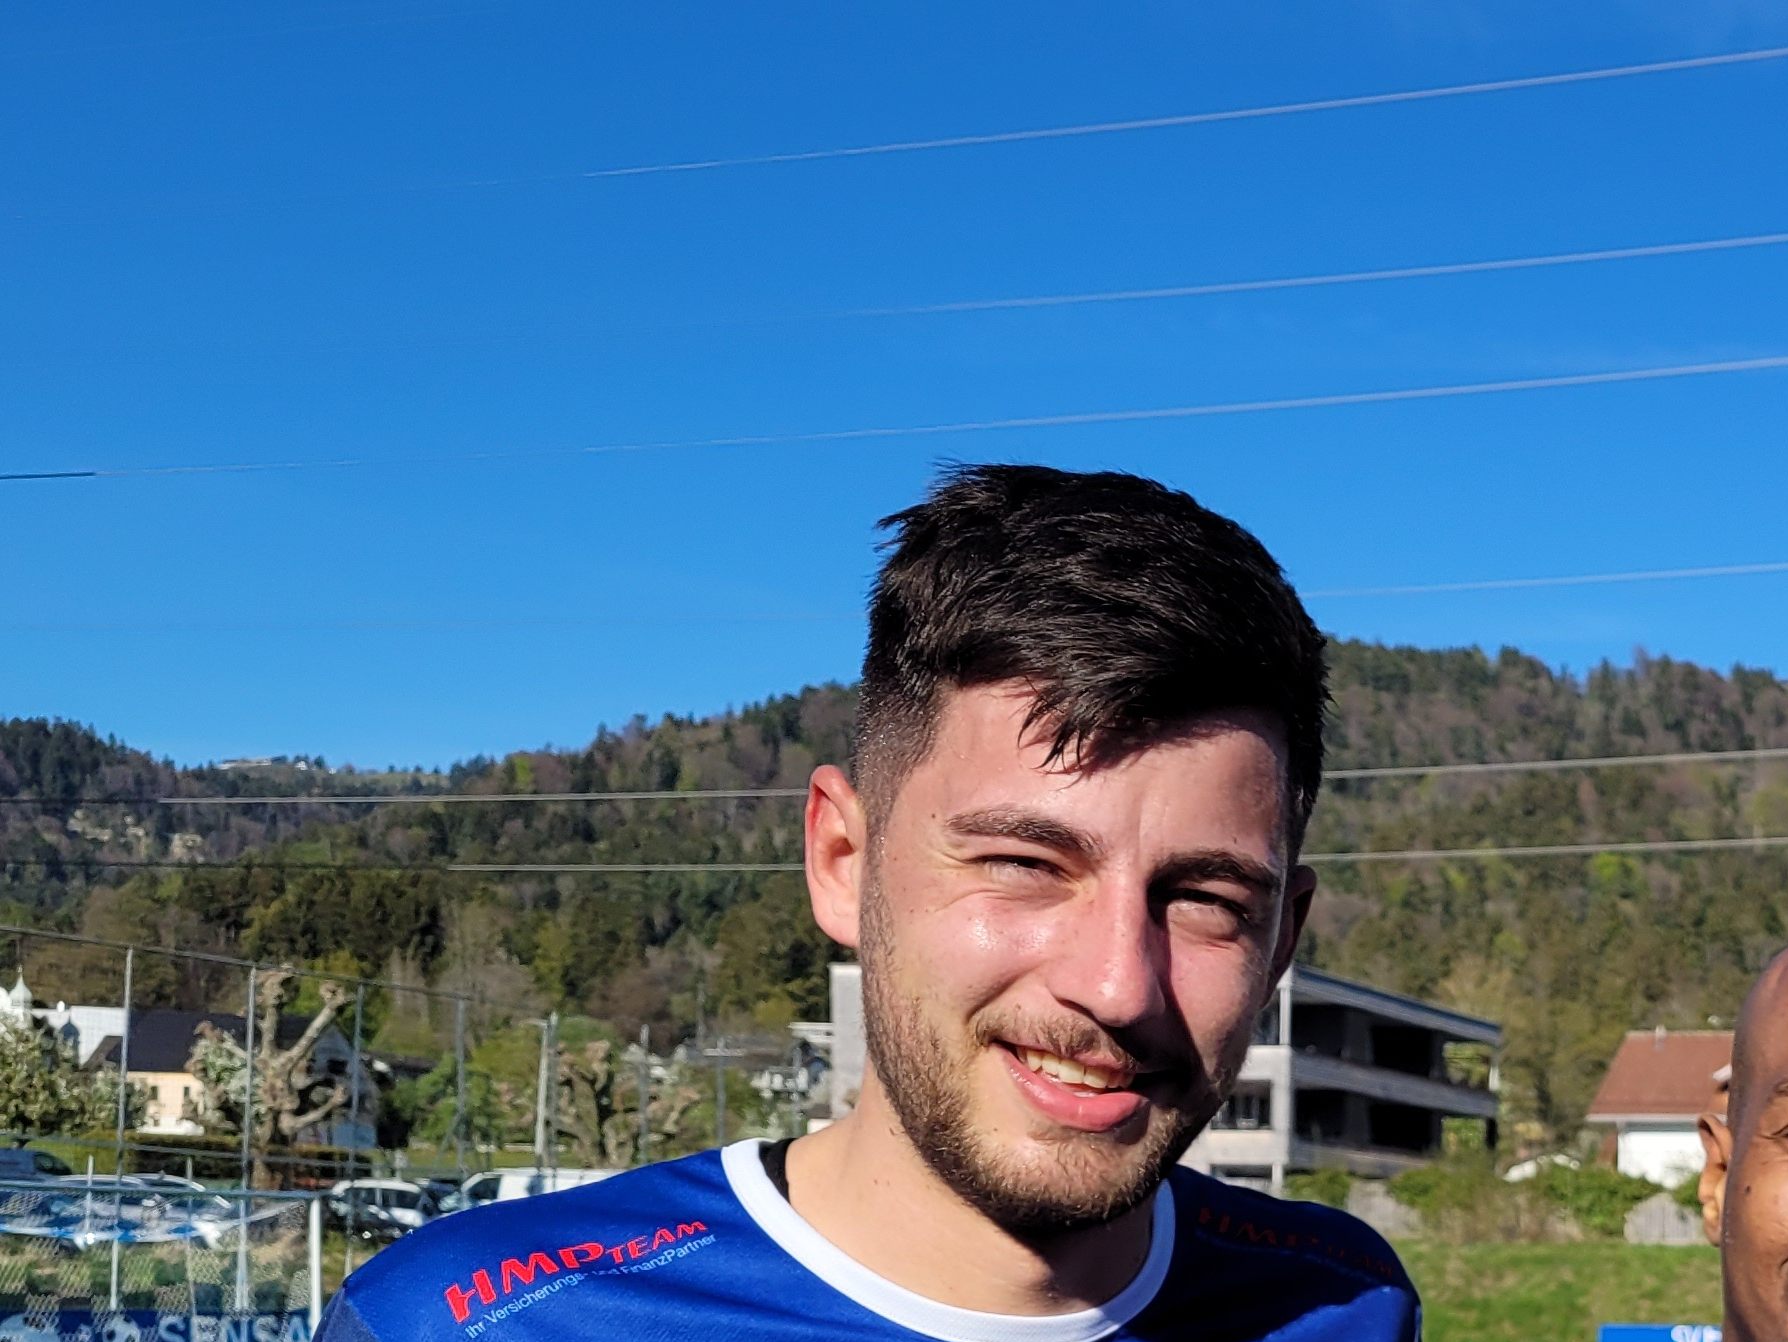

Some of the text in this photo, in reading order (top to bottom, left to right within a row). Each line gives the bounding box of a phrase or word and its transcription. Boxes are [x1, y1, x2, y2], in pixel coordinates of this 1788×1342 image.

[465, 1321, 487, 1339] Ihr
[484, 1271, 590, 1323] Versicherungs-
[619, 1234, 717, 1274] FinanzPartner
